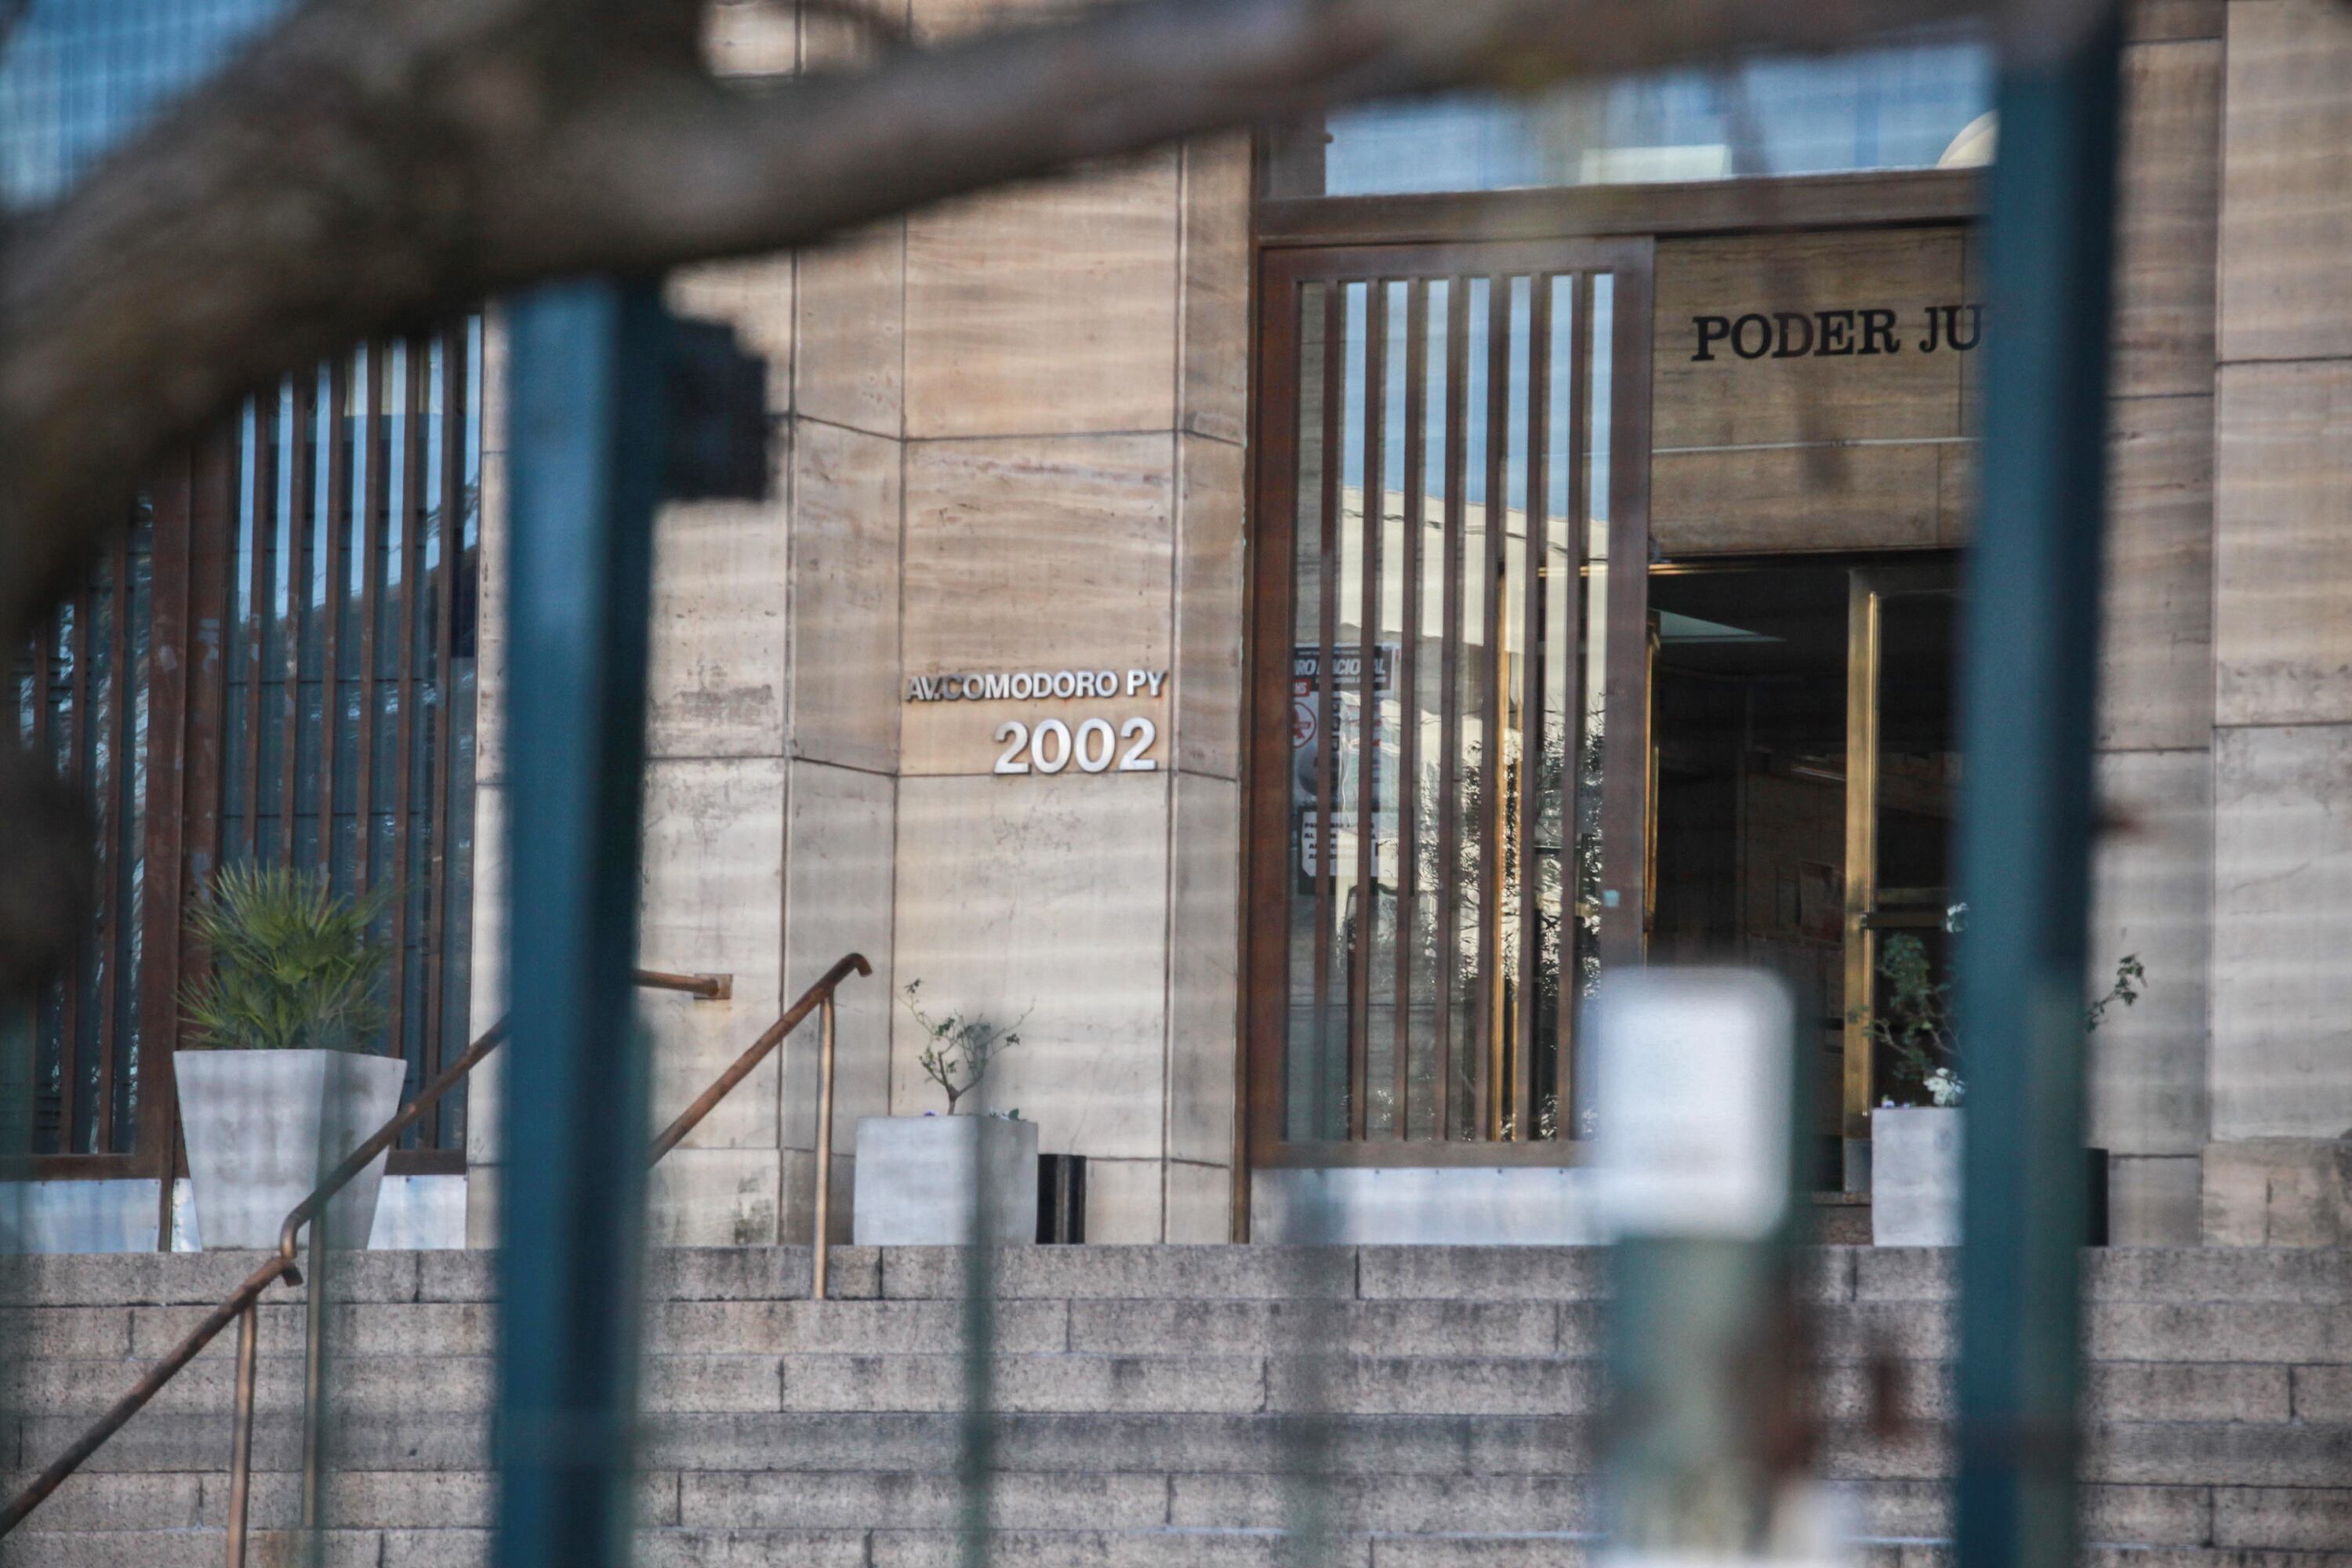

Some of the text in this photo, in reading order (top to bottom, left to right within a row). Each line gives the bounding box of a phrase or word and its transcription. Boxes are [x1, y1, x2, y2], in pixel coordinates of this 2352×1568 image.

[1690, 303, 1986, 361] PODER JU
[1127, 670, 1167, 696] PY
[993, 717, 1157, 775] 2002
